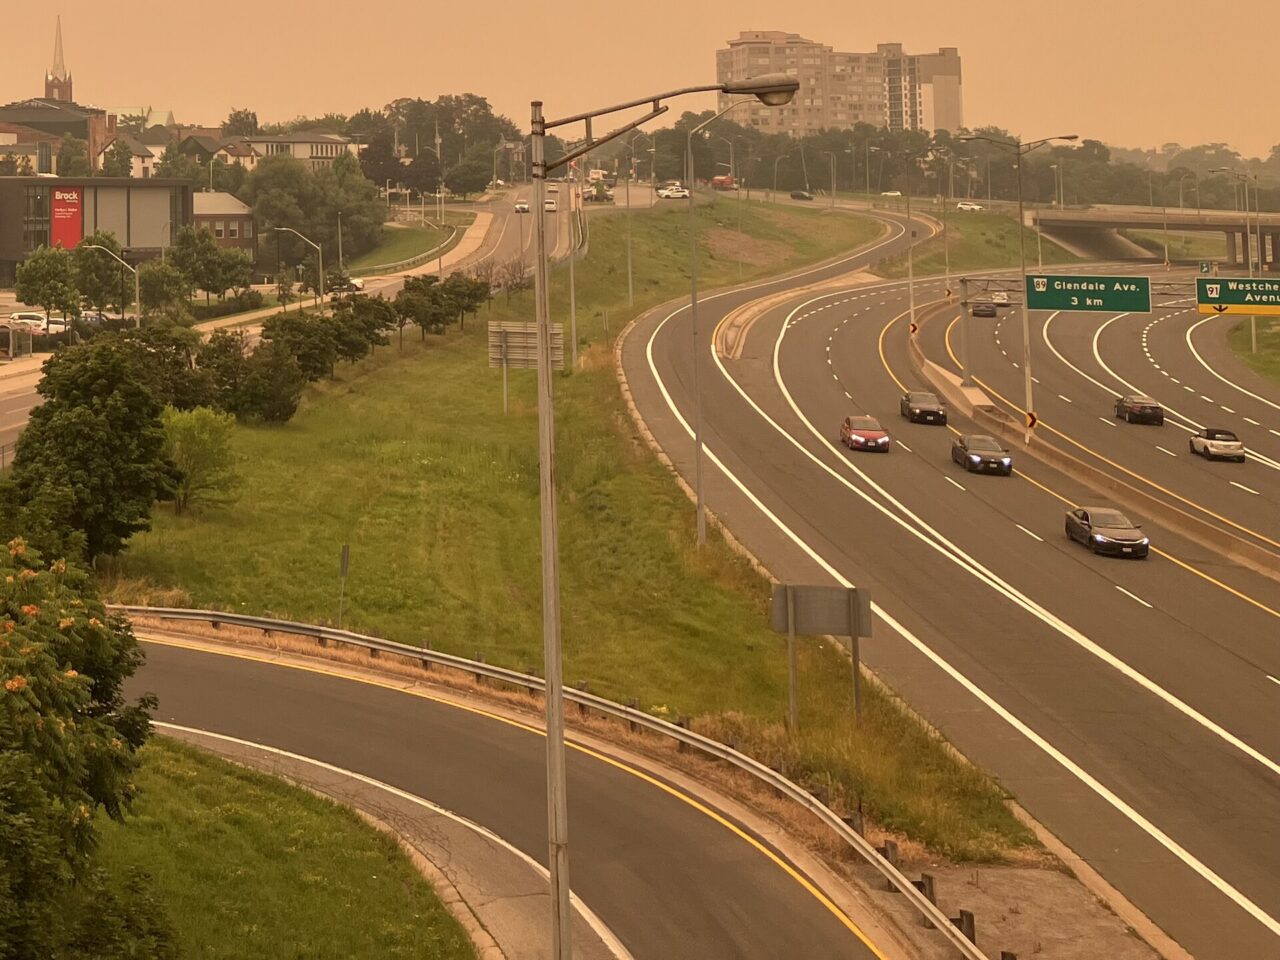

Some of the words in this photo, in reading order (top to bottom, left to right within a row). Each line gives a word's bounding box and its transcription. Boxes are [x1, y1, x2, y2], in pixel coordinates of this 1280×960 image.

[55, 191, 78, 200] Brock
[1035, 280, 1046, 289] 89
[1054, 281, 1106, 291] Glendale
[1113, 282, 1140, 292] Ave.
[1208, 286, 1219, 296] 91
[1228, 281, 1280, 291] Westche
[1071, 297, 1078, 306] 3
[1086, 297, 1103, 306] km
